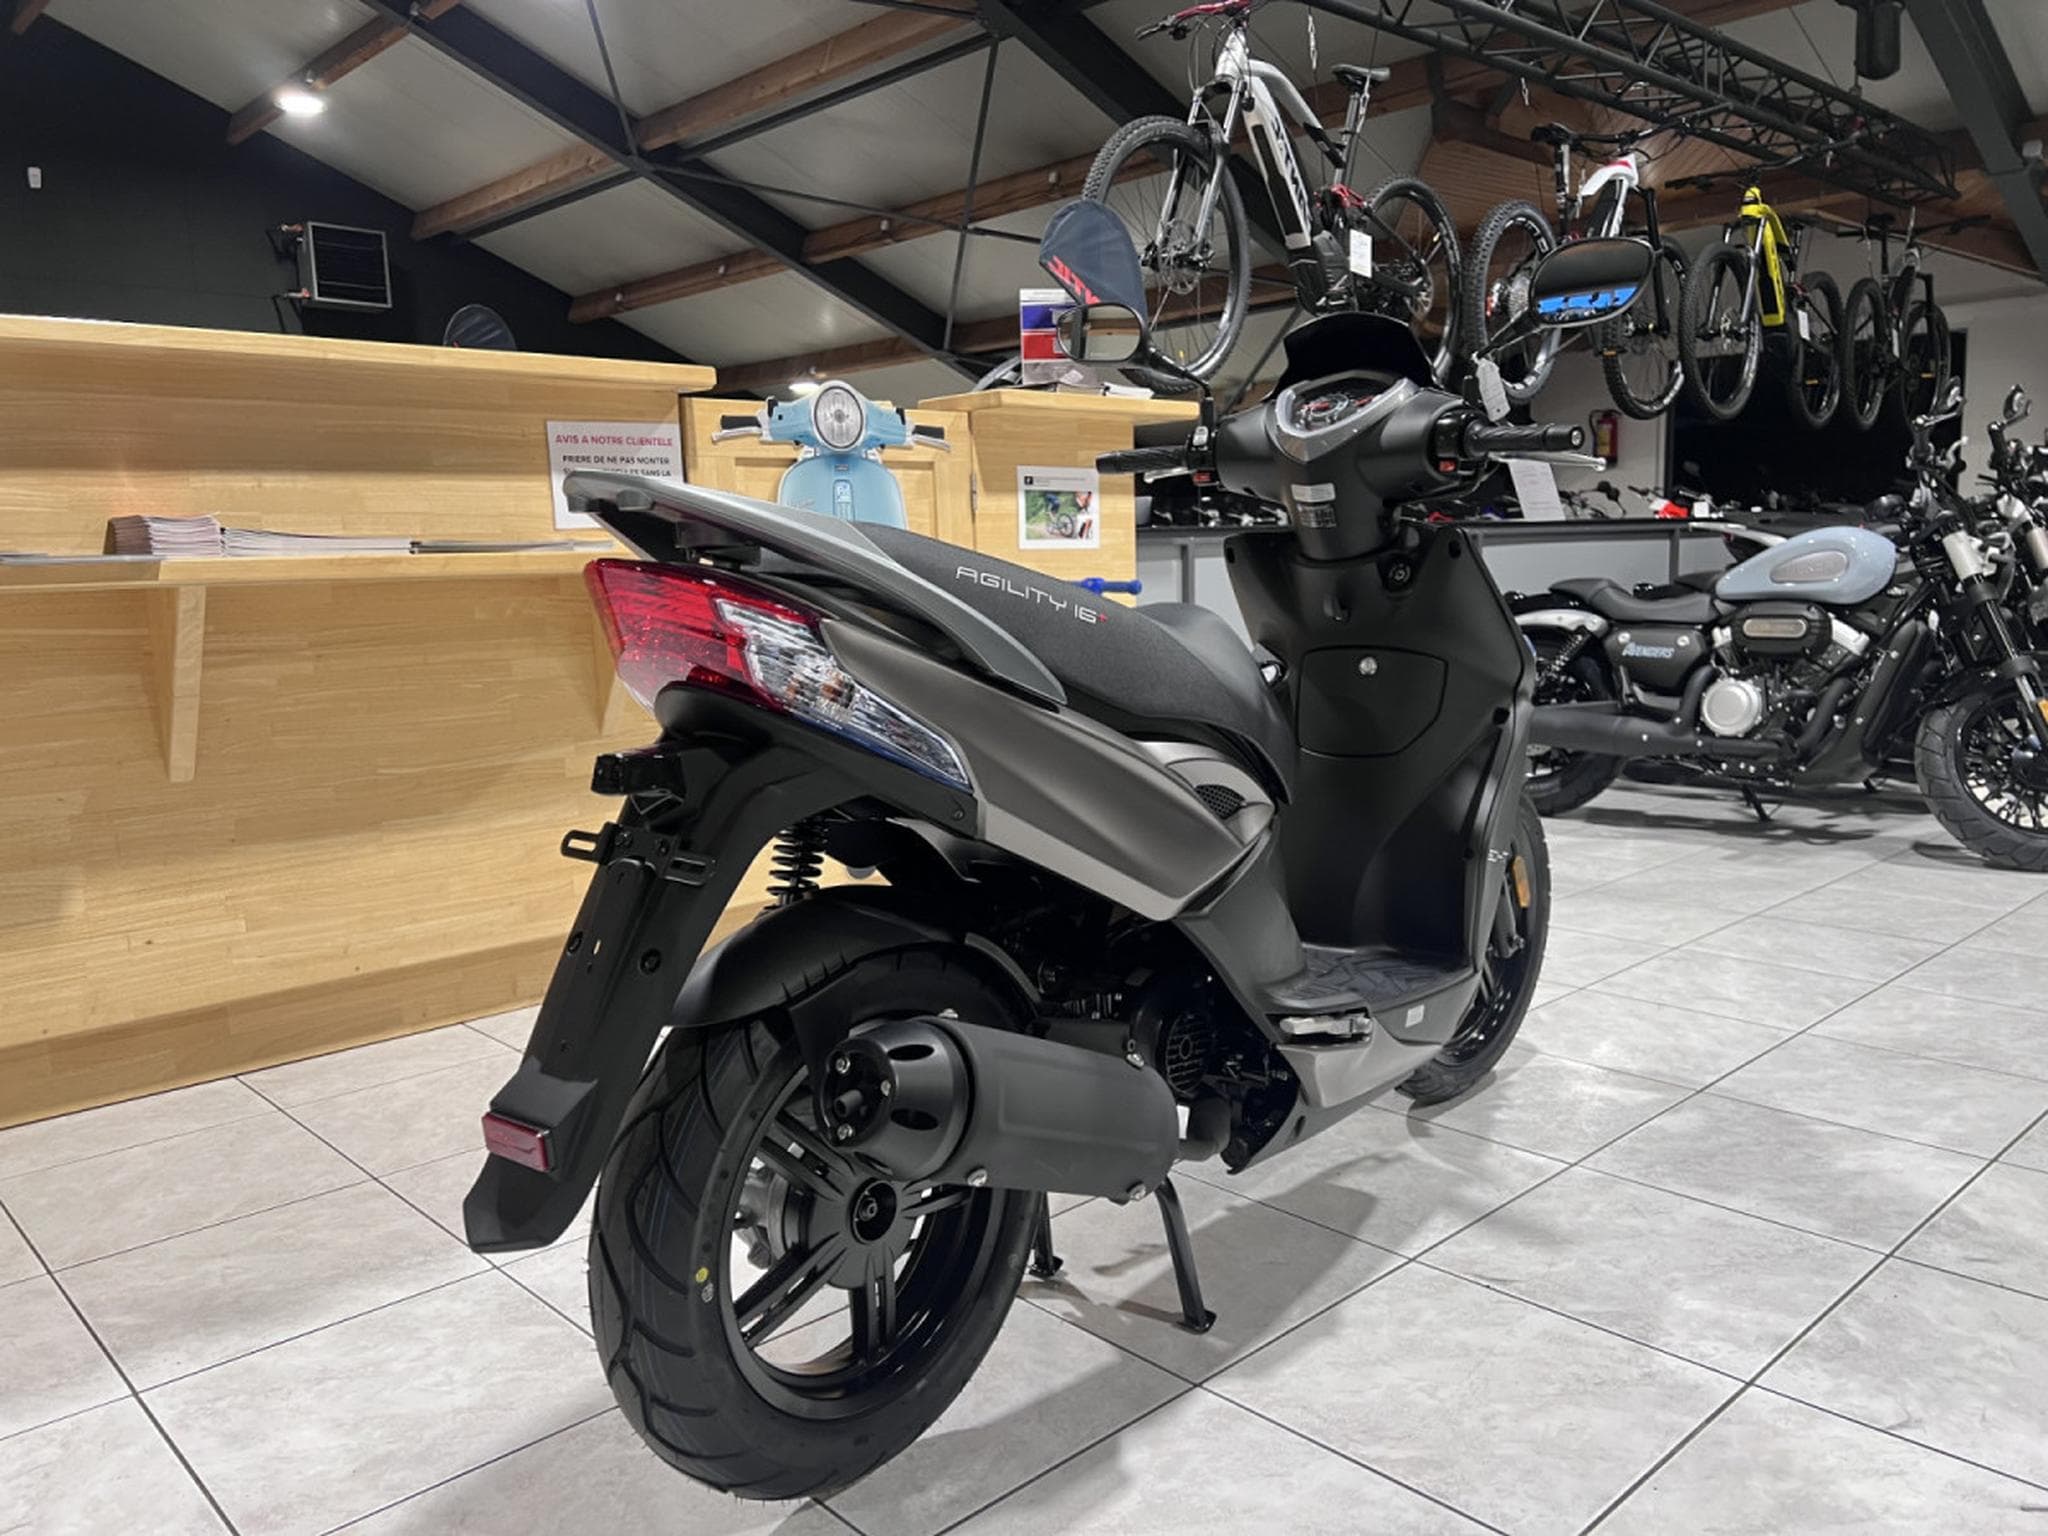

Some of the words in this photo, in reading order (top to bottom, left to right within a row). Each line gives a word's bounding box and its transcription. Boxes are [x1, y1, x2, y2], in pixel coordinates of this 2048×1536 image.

[555, 434, 579, 444] AVIS
[591, 436, 624, 445] NOTRE
[625, 437, 673, 446] CLIENTELE
[563, 454, 592, 463] PRIERE
[593, 455, 605, 464] DE
[606, 455, 618, 464] NE
[620, 456, 636, 465] PAS
[637, 457, 670, 465] MONTER
[955, 565, 1067, 611] AGILITY
